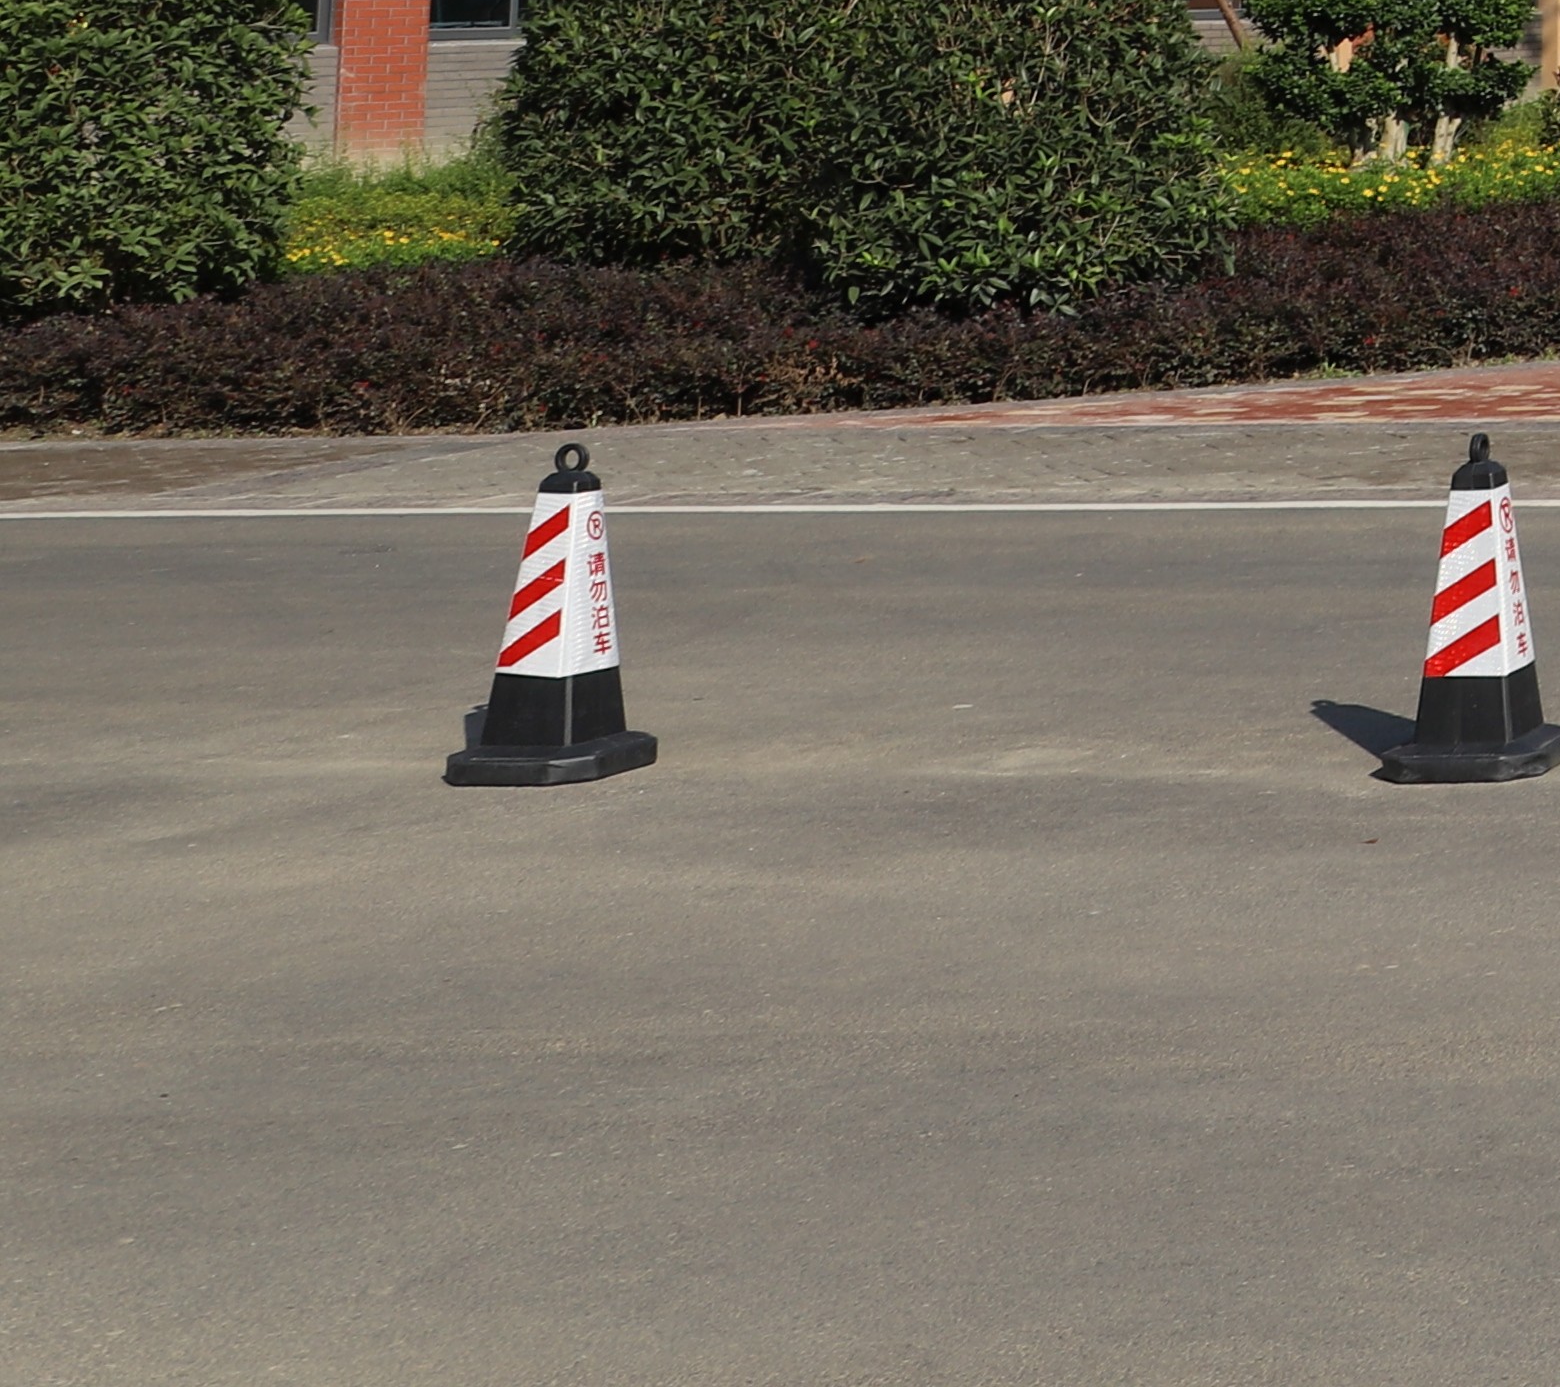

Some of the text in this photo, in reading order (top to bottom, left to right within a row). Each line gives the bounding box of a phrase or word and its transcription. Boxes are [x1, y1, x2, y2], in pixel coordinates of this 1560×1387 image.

[586, 551, 612, 655] 请勿泊车
[1505, 536, 1529, 657] 请勿泊车
